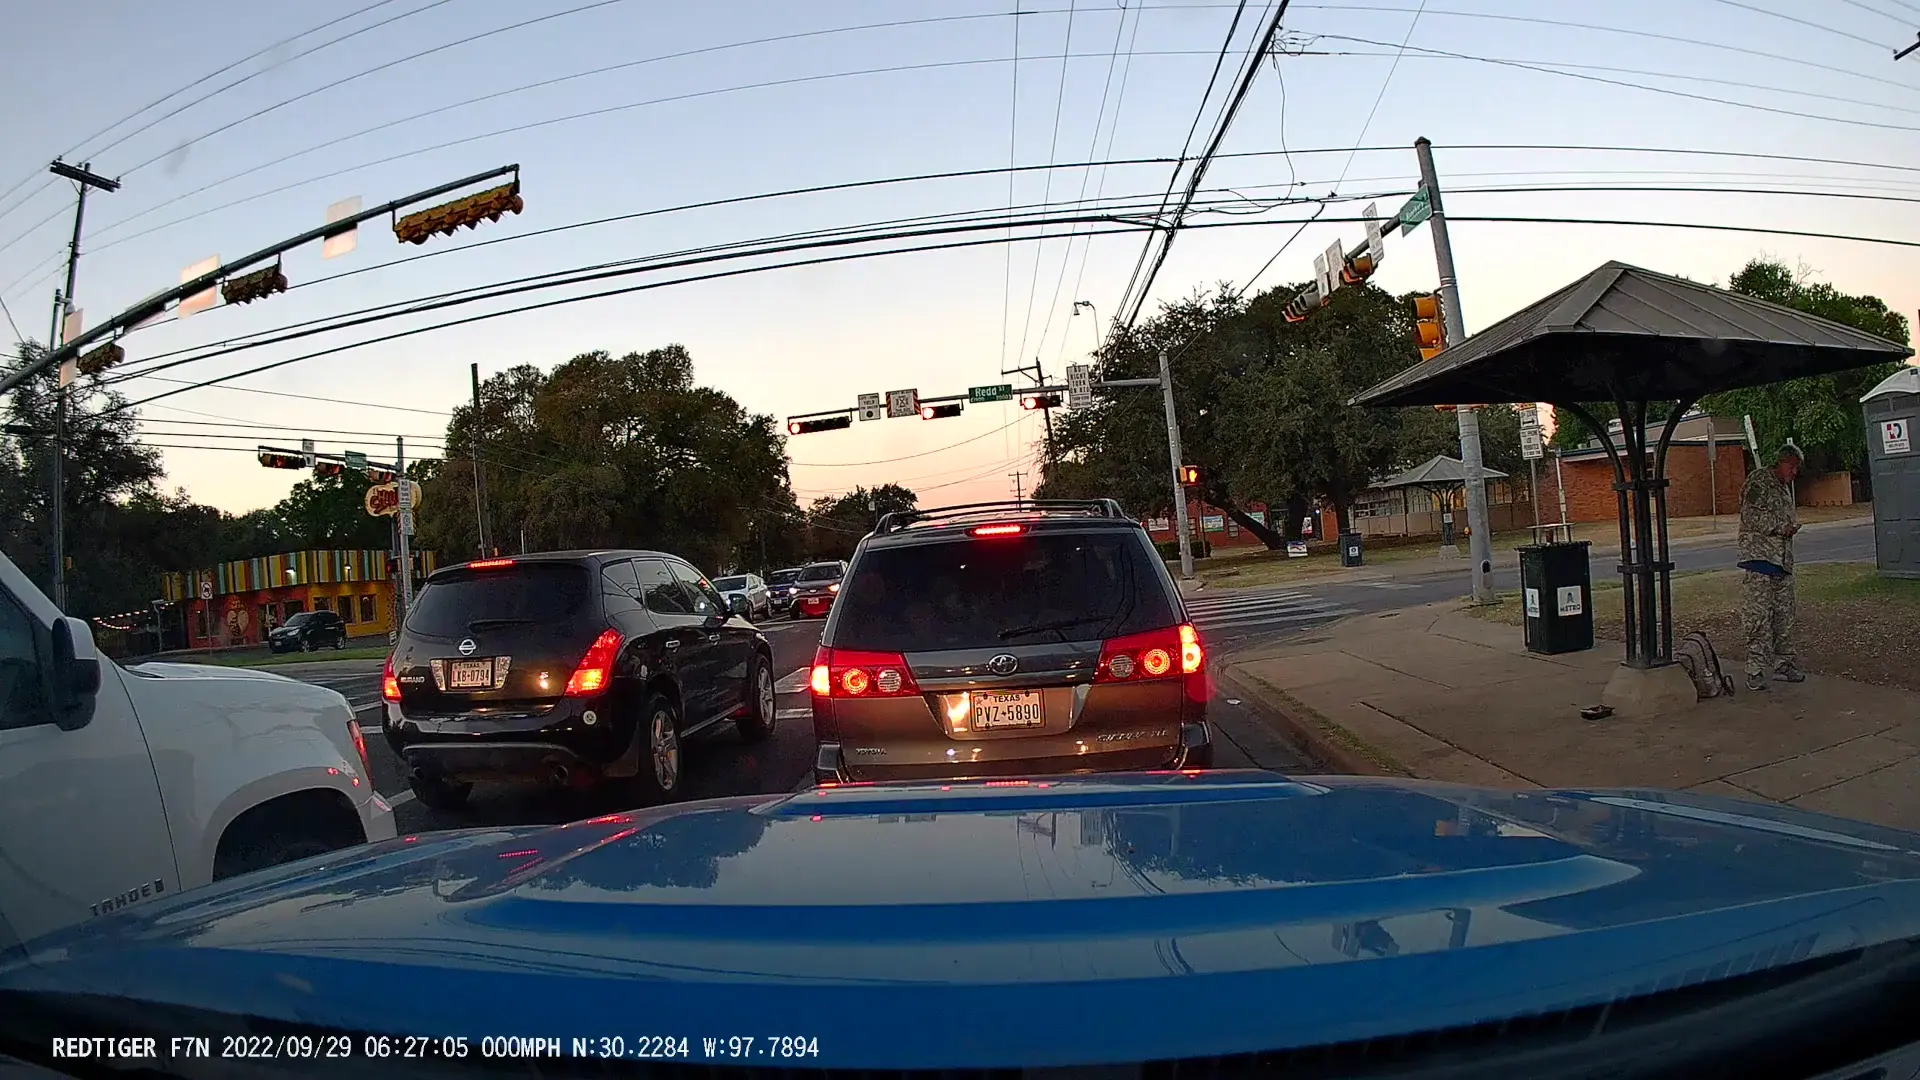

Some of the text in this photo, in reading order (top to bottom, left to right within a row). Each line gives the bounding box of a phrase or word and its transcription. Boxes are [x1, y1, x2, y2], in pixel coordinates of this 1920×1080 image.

[975, 387, 997, 397] Redd
[1560, 604, 1581, 612] METRO
[993, 694, 1021, 703] TEXAS
[855, 747, 888, 756] TOYOTA
[89, 882, 152, 917] TAHOE
